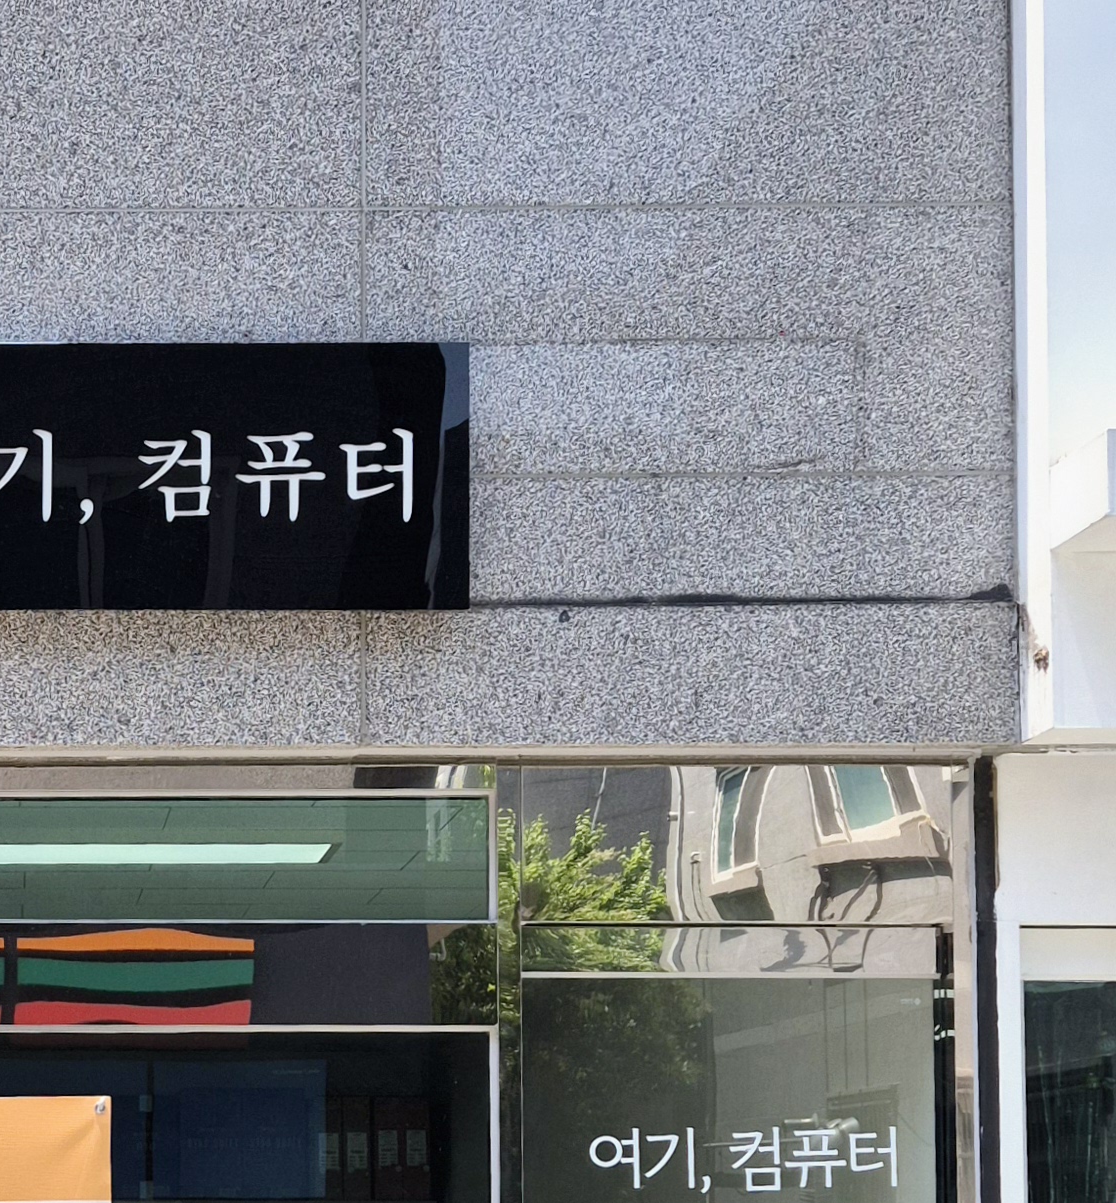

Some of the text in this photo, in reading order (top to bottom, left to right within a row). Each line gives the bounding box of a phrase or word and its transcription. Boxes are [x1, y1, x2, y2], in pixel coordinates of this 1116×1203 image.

[139, 428, 413, 522] 컴퓨터
[590, 1127, 898, 1193] 여기, 컴퓨터
